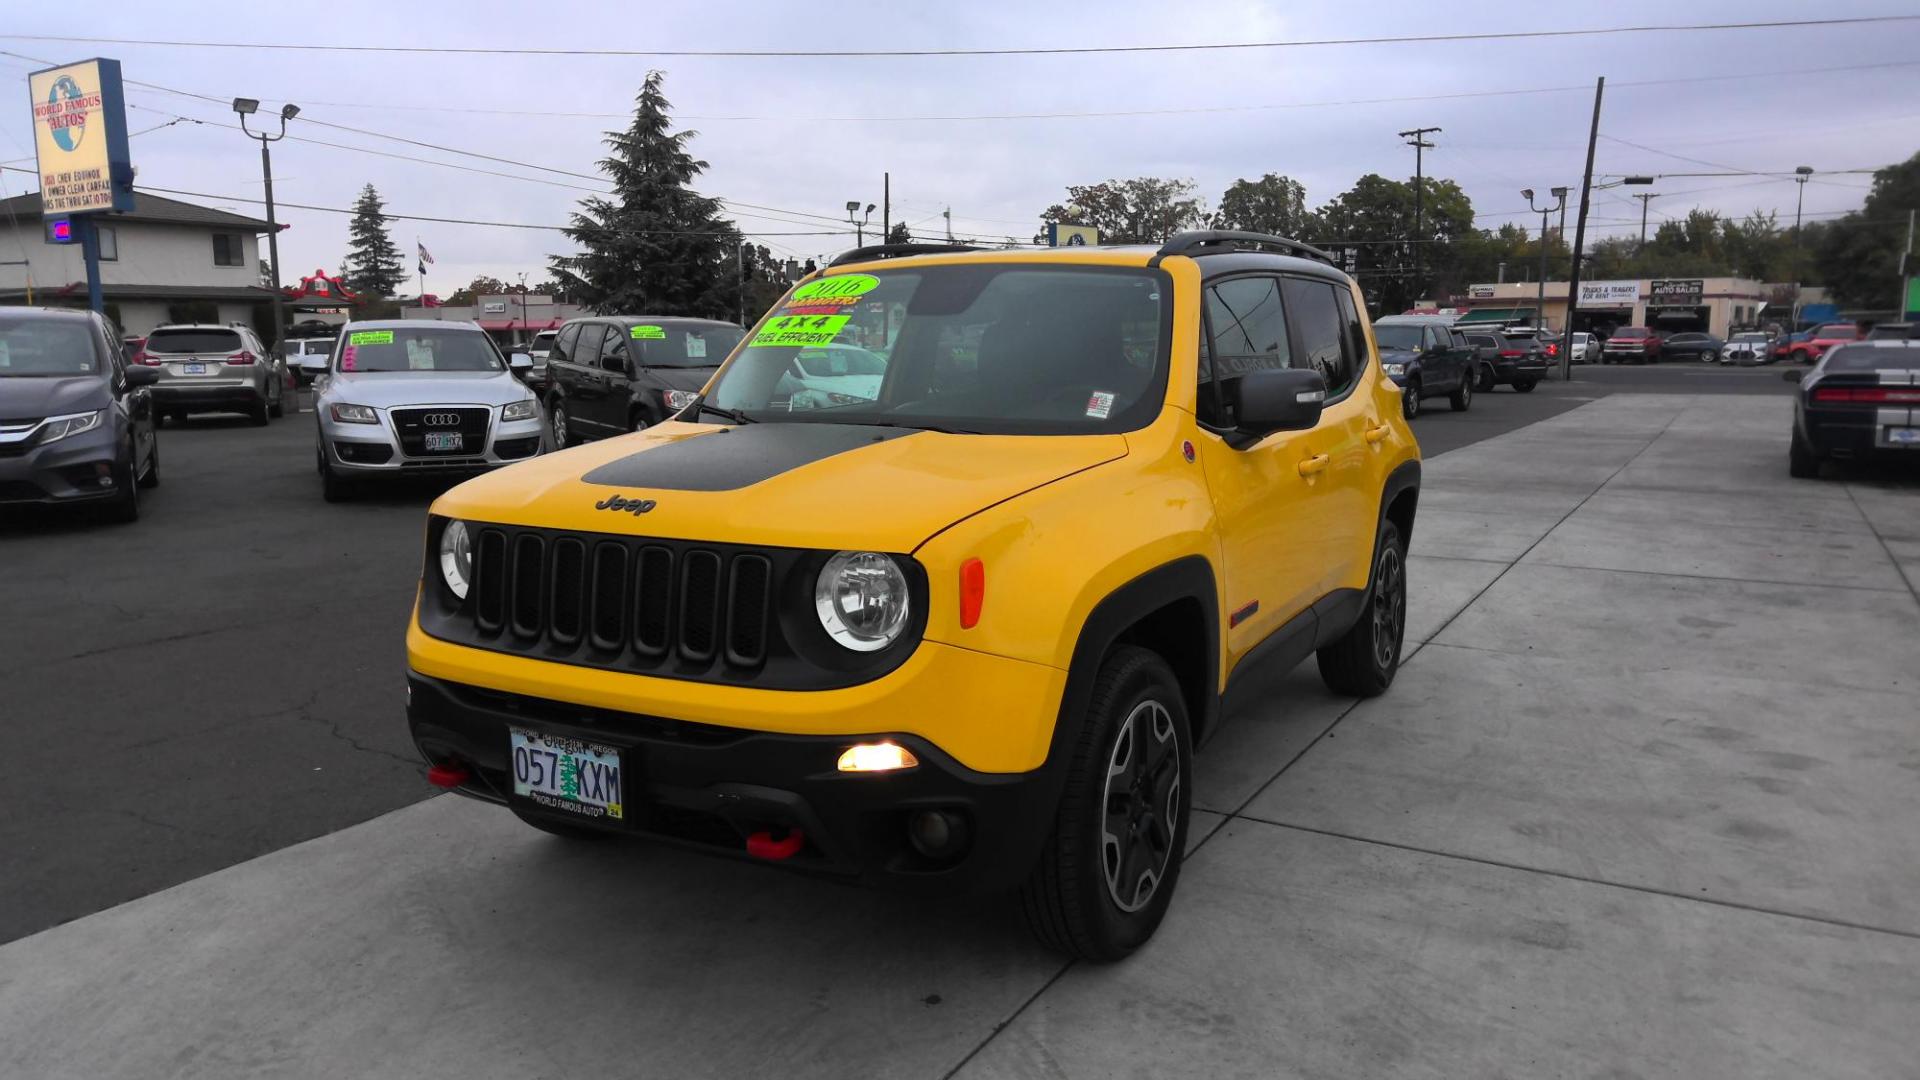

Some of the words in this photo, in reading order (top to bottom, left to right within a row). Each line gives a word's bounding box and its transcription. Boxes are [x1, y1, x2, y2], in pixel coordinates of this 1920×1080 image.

[35, 102, 63, 116] WORLD
[64, 95, 101, 111] FAMOUS
[1653, 285, 1675, 294] AUTO
[1675, 286, 1700, 294] SALES
[776, 331, 834, 344] EFFICIENT
[595, 494, 656, 516] Jeep
[515, 746, 559, 791] 057
[575, 757, 621, 804] KXM
[557, 799, 582, 813] FAMOUS
